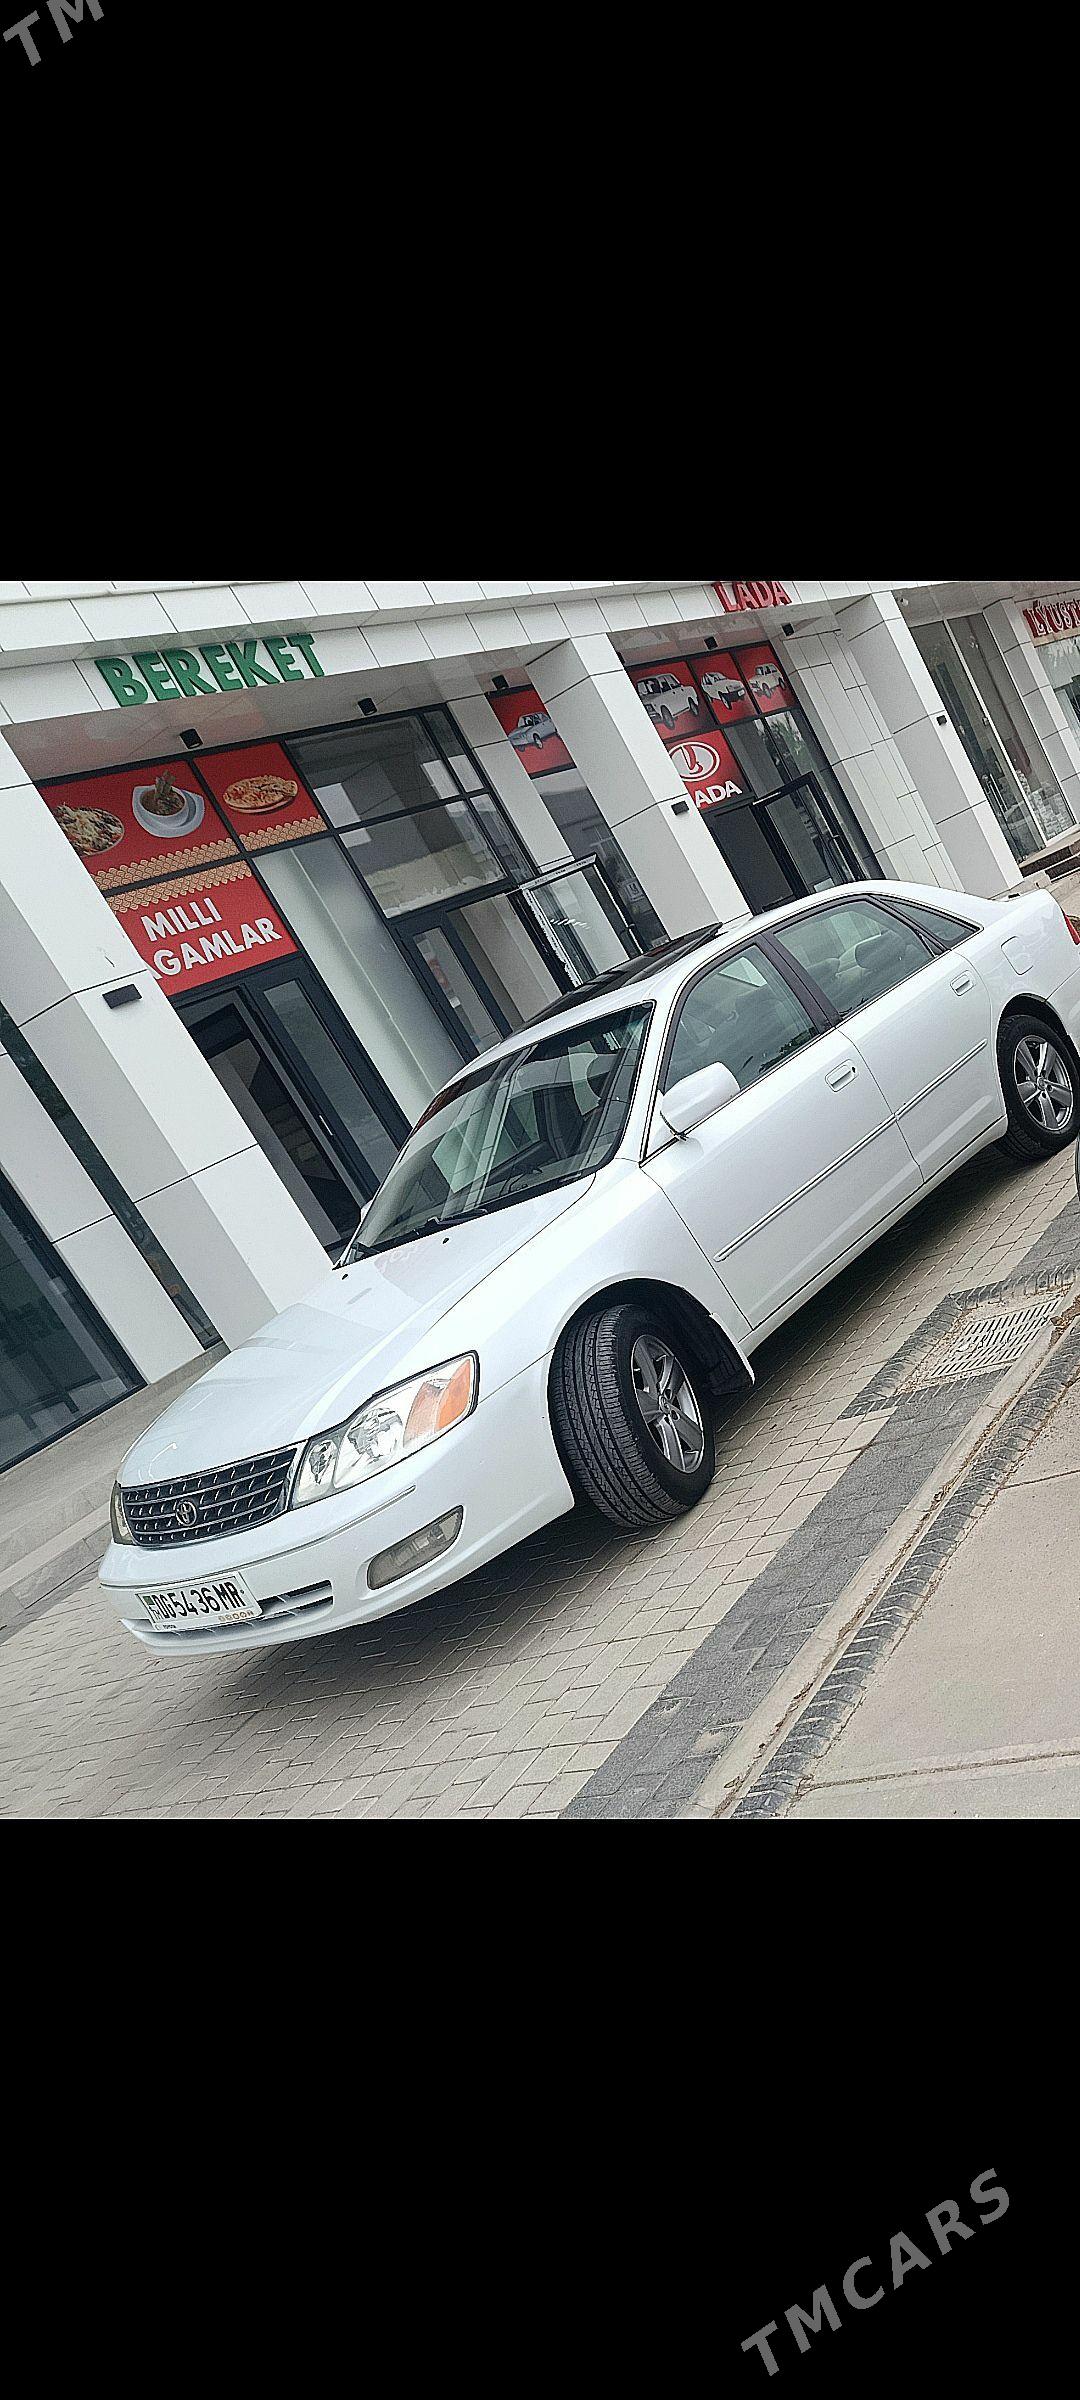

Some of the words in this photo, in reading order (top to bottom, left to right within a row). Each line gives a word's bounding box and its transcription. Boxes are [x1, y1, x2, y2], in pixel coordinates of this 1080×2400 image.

[711, 581, 792, 613] LADA
[1022, 600, 1080, 638] LÝUST
[94, 633, 325, 707] BEREKET
[694, 780, 742, 808] ADA
[141, 897, 222, 942] MILLI
[146, 917, 282, 980] GAMLAR
